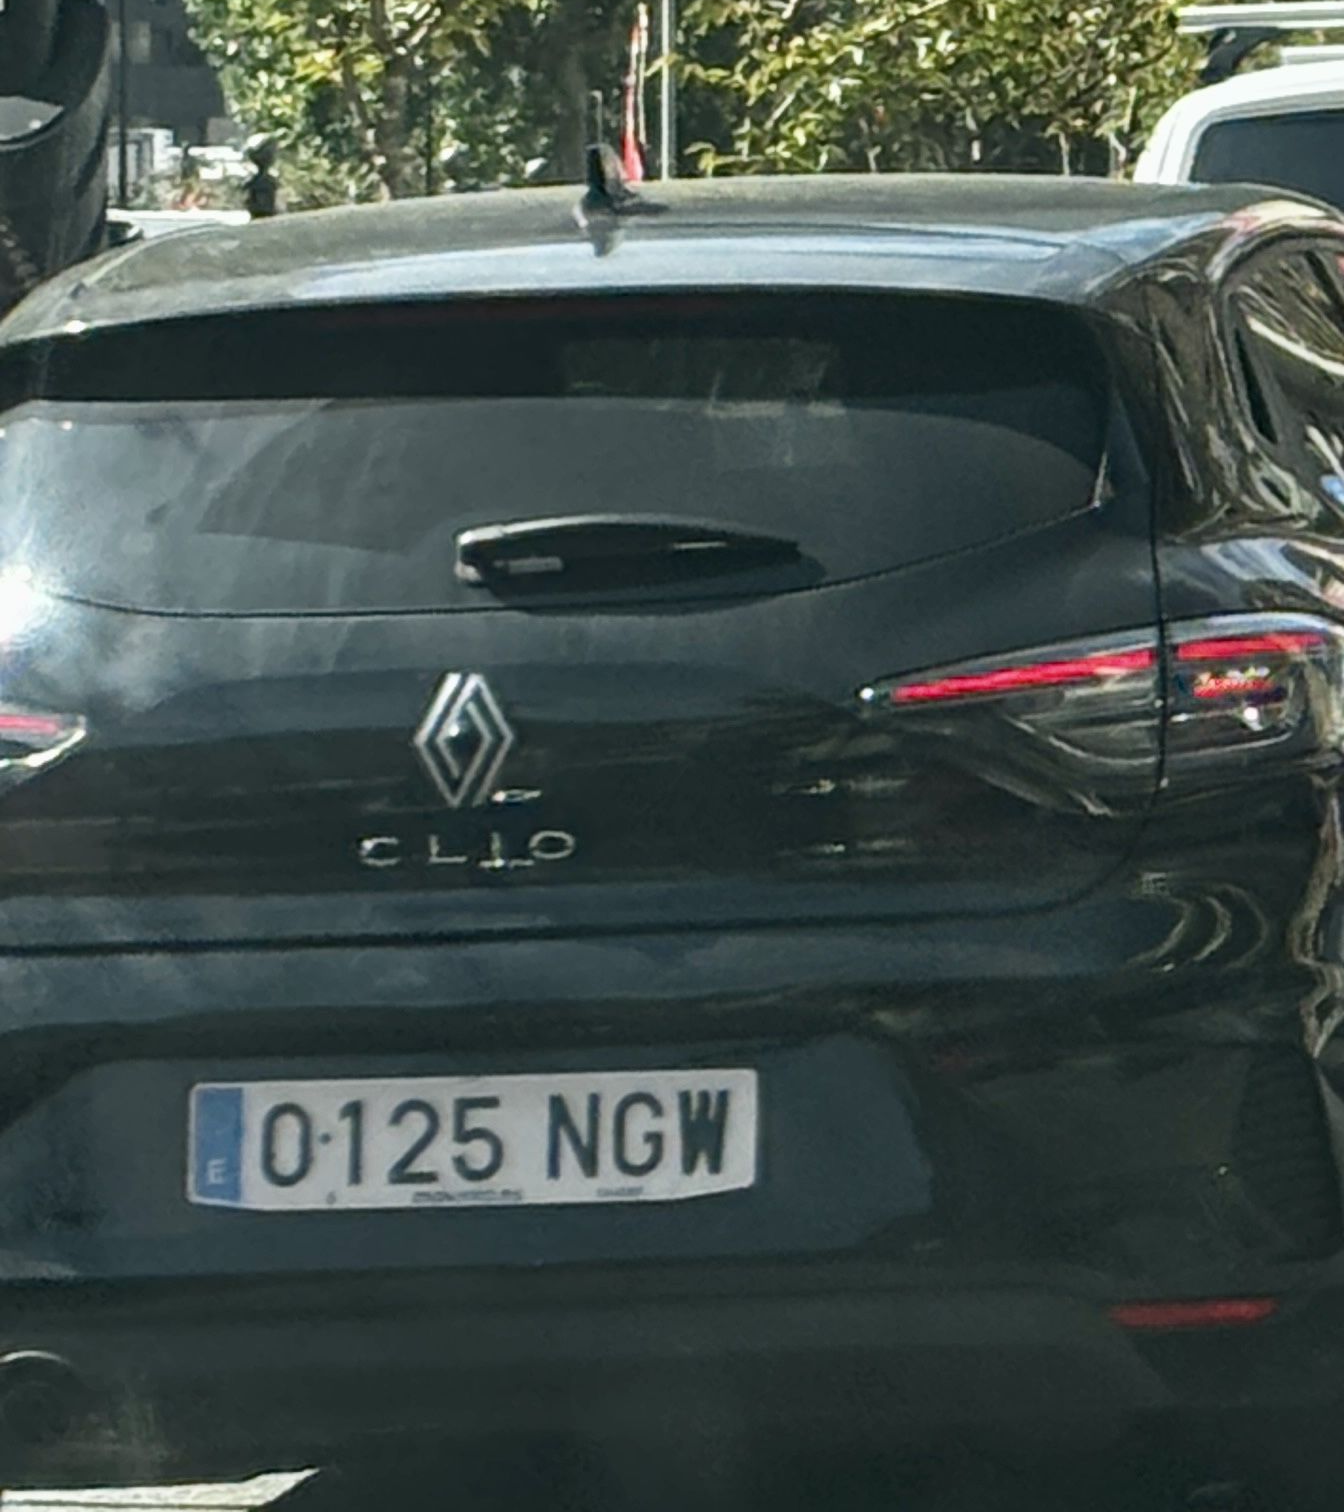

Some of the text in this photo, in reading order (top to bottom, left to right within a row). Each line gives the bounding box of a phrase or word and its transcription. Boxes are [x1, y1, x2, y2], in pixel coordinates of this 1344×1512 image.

[359, 829, 576, 869] CLIO
[261, 1096, 504, 1188] 0125
[546, 1089, 730, 1181] NGW
